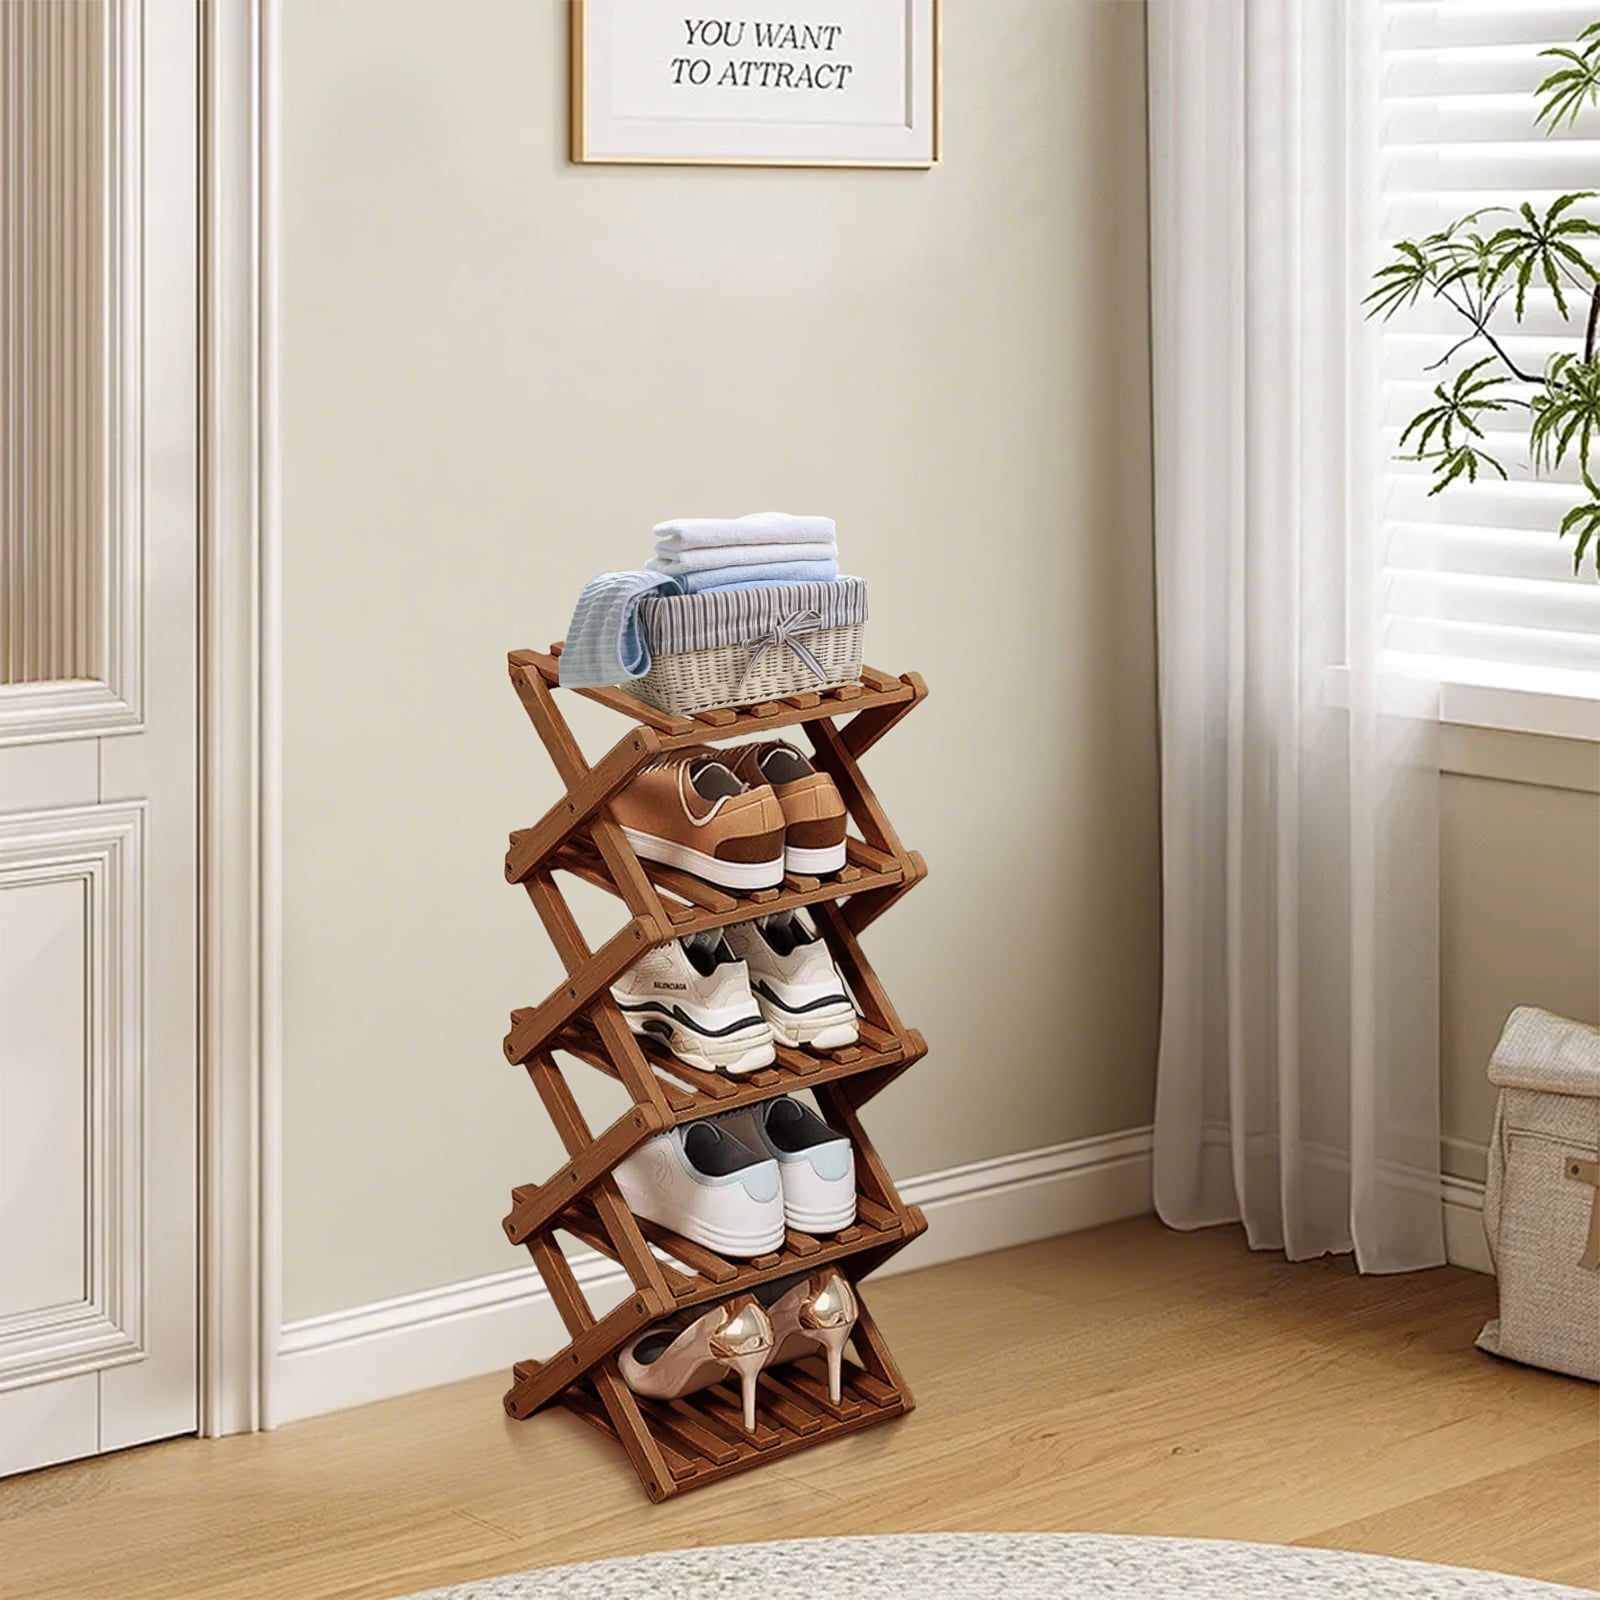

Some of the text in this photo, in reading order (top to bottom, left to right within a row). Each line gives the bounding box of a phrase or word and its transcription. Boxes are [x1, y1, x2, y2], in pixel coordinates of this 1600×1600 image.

[684, 19, 843, 50] YOU WANT
[671, 58, 853, 89] TO ATTRACT
